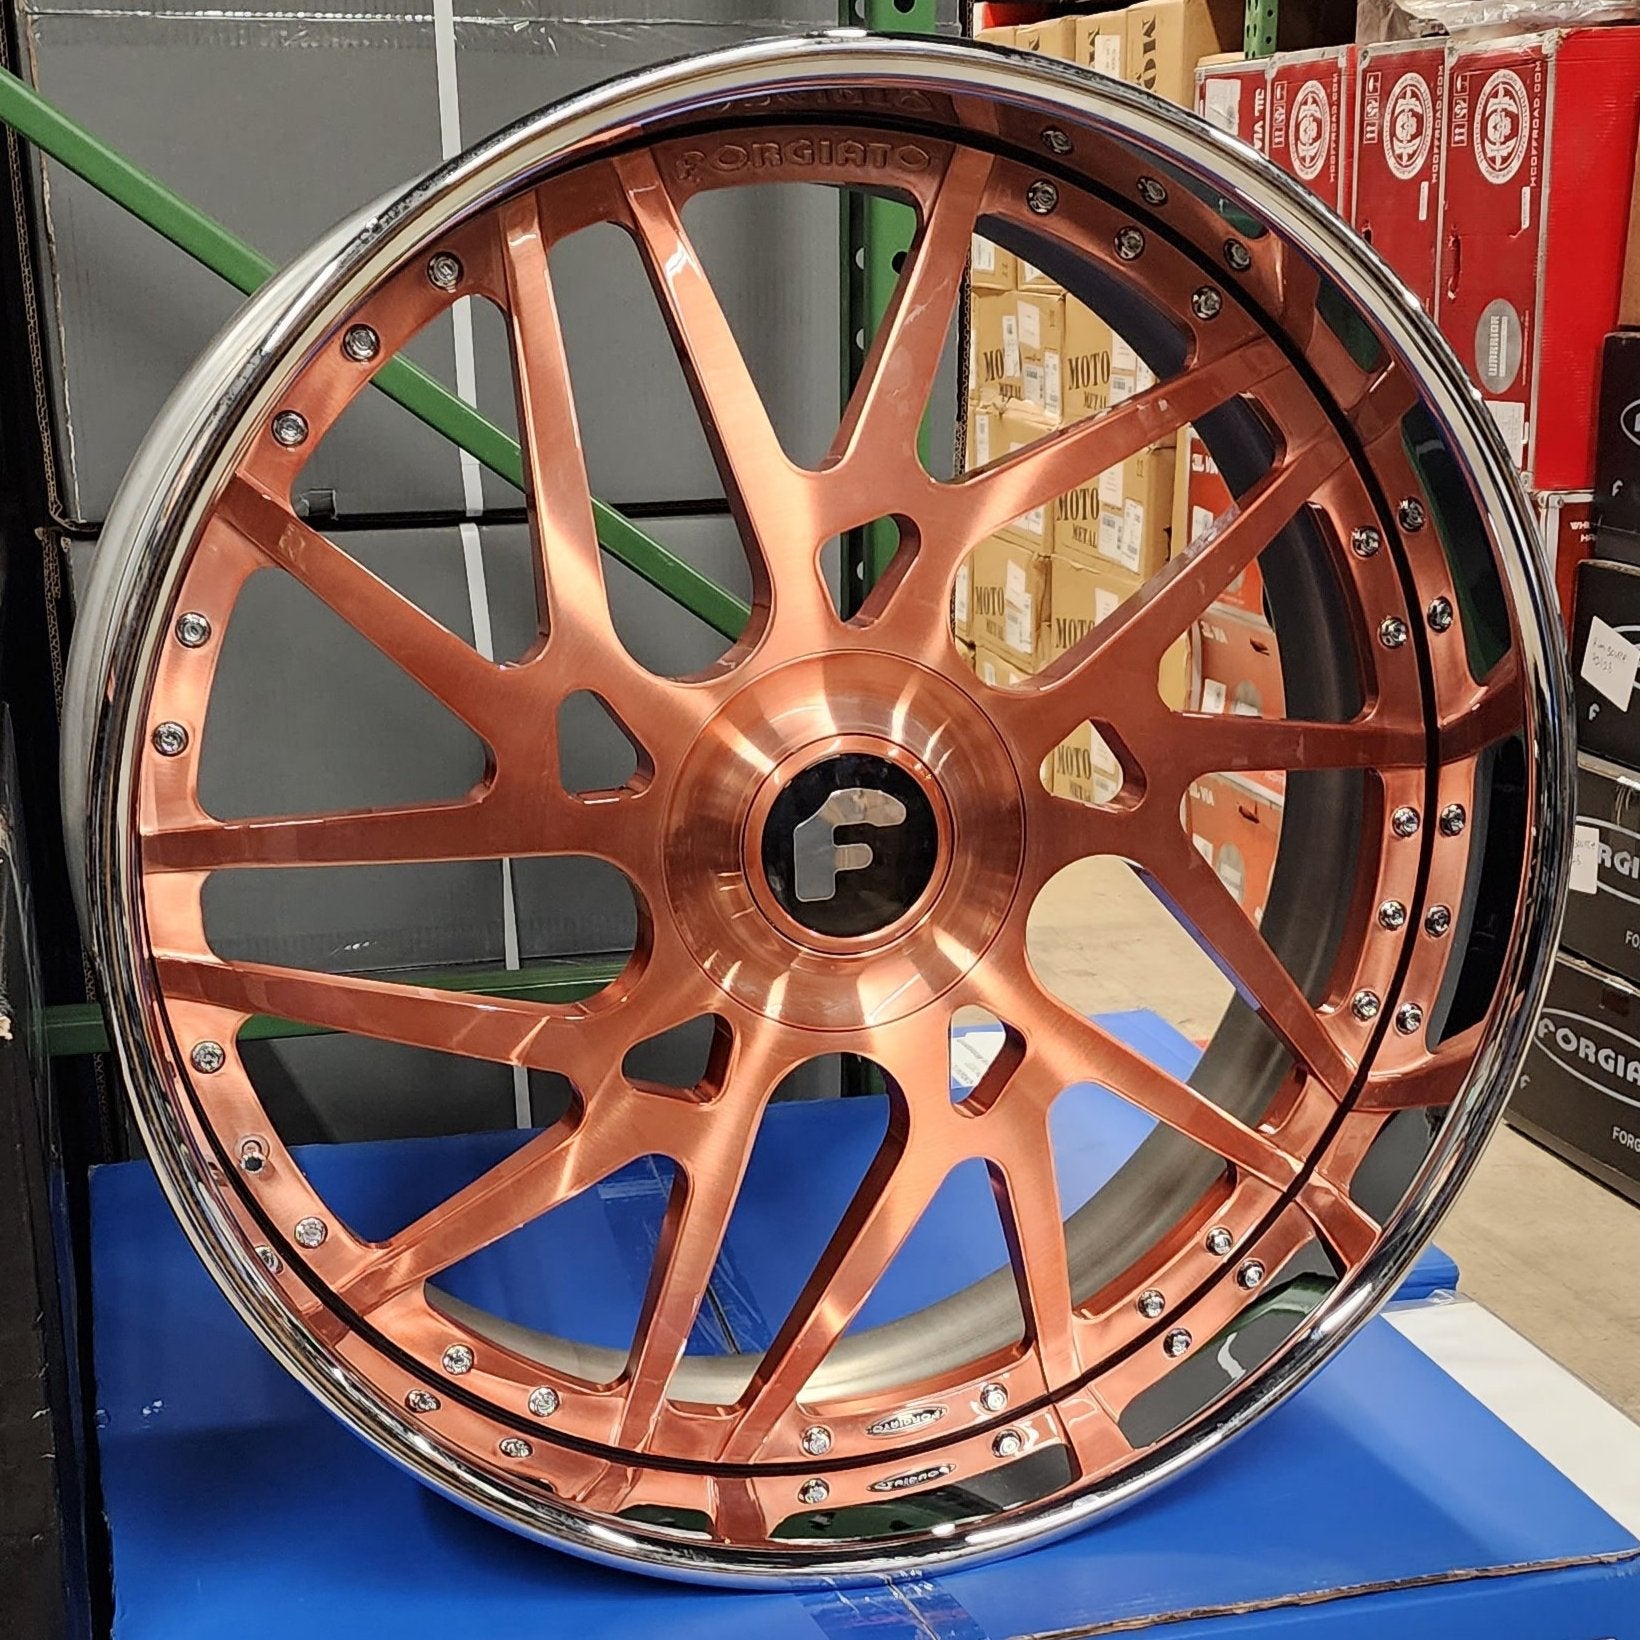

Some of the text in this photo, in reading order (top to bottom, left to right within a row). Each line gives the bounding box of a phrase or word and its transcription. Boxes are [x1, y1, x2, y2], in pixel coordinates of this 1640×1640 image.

[674, 140, 931, 182] FORGIATO
[1487, 315, 1500, 377] WARRIOR
[1068, 351, 1110, 391] MOTO
[1056, 487, 1100, 521] MOTO
[1072, 522, 1098, 549] METAL
[975, 586, 1004, 616] MOTO
[1056, 745, 1092, 780] MOTO
[793, 787, 907, 902] F
